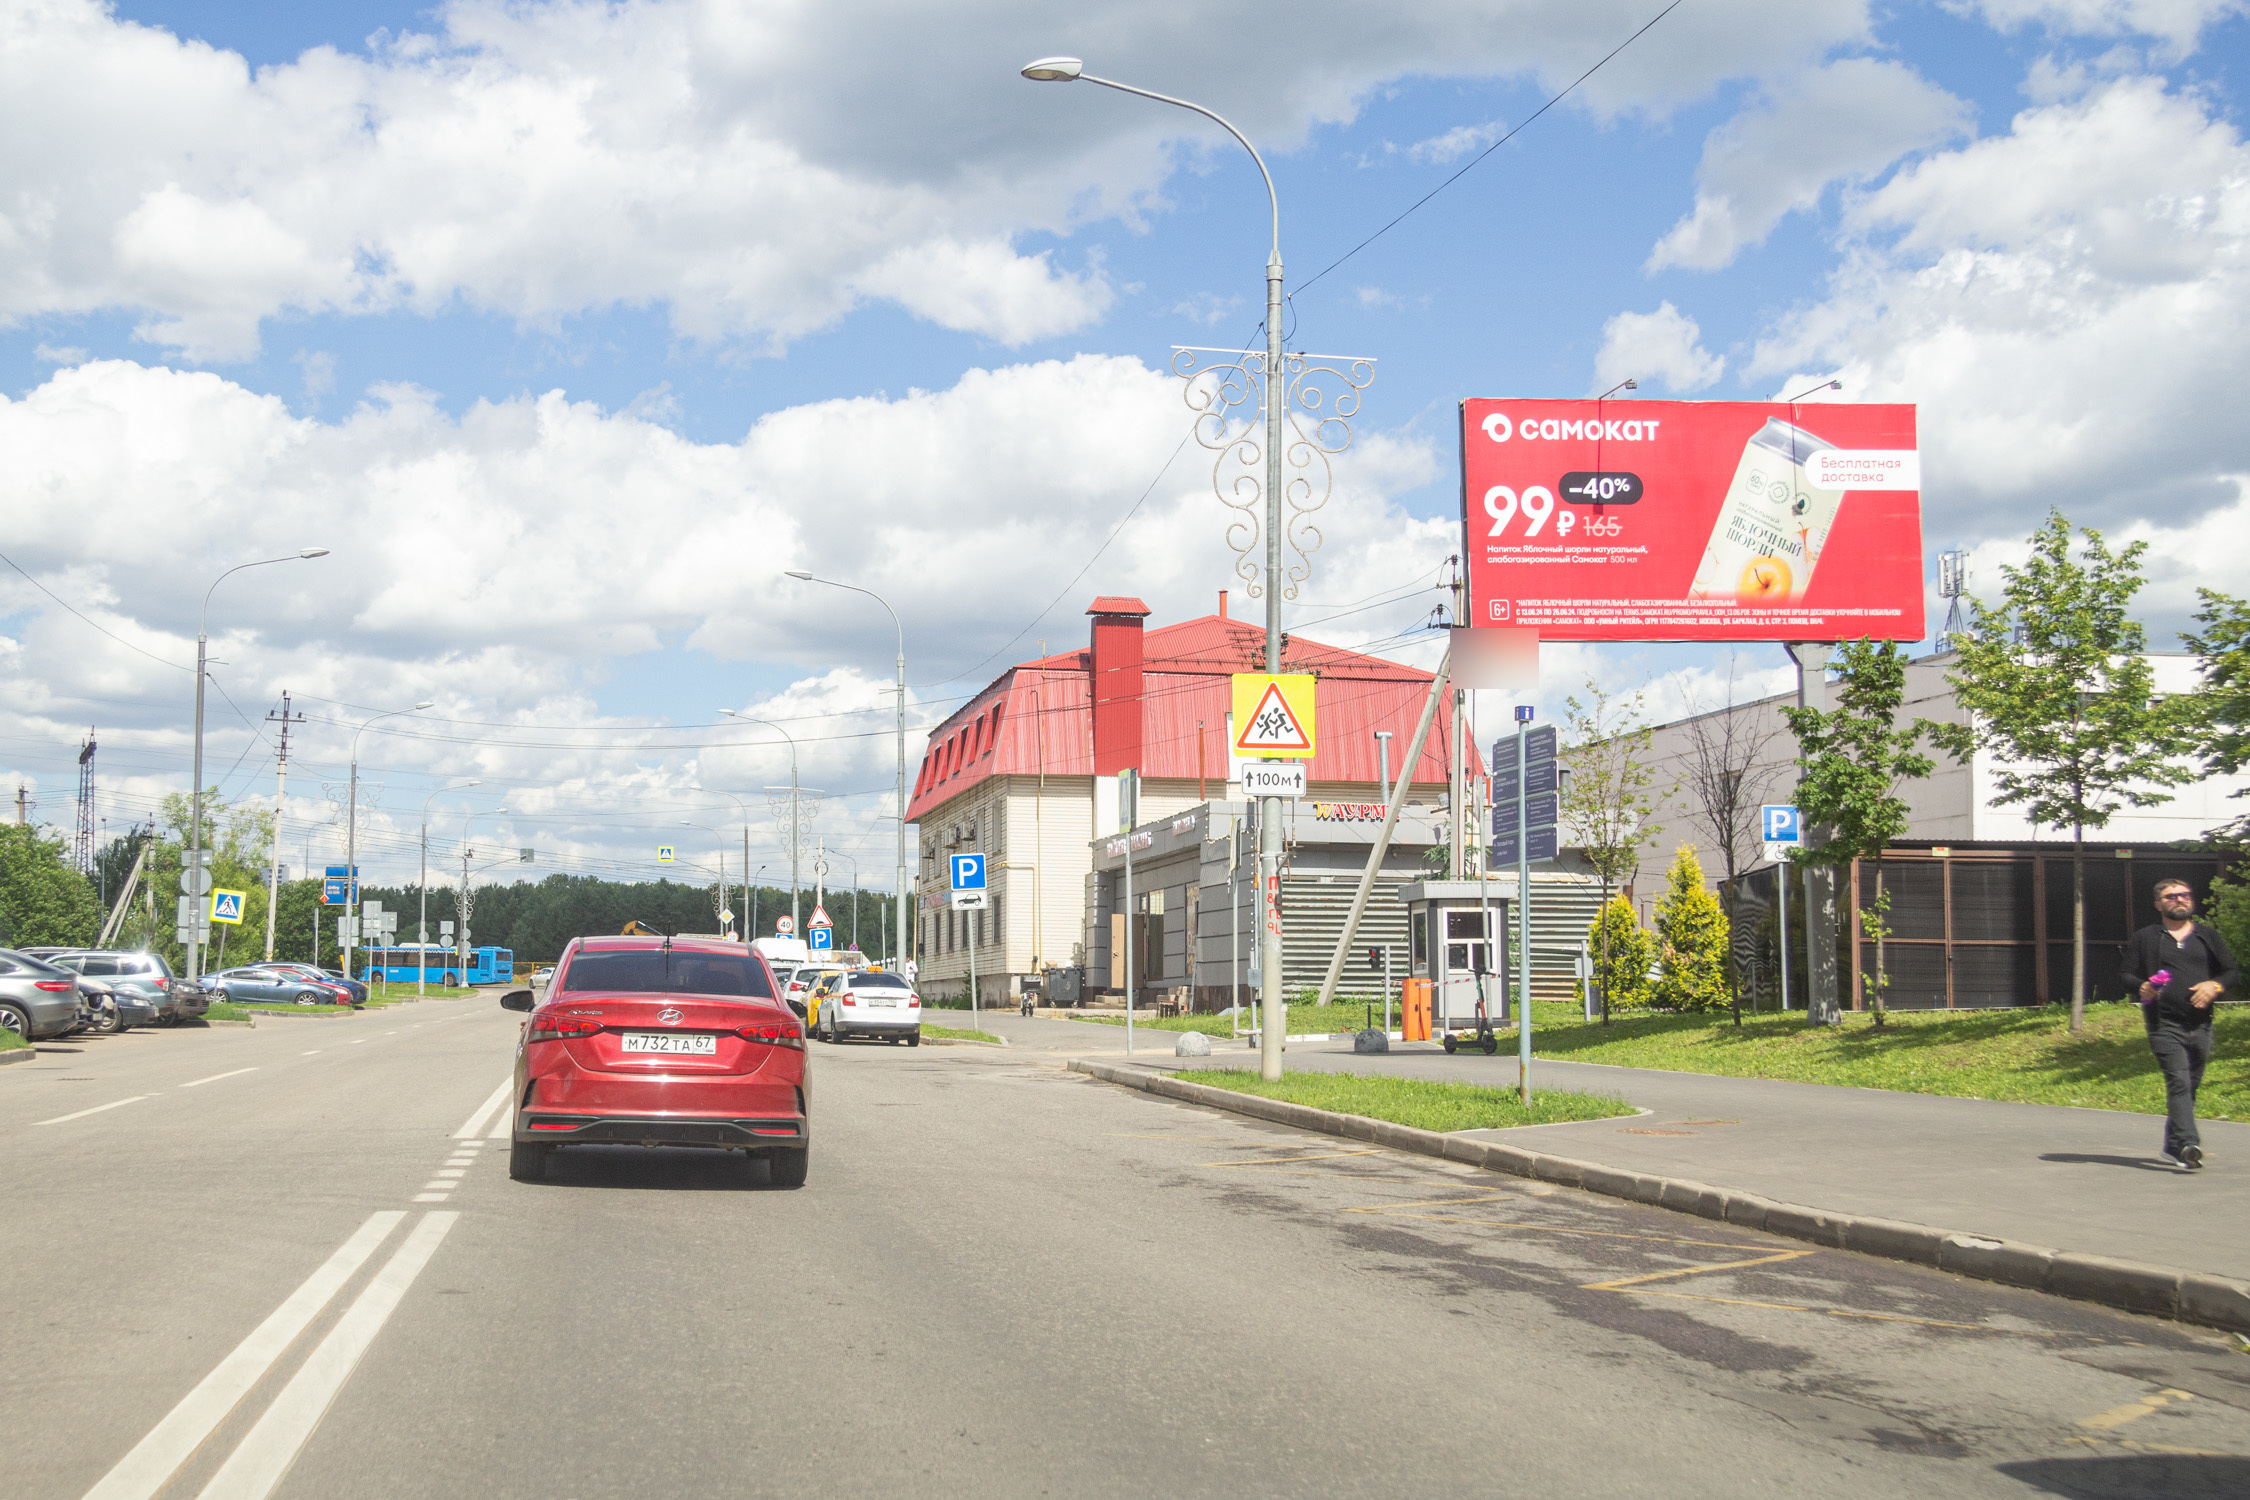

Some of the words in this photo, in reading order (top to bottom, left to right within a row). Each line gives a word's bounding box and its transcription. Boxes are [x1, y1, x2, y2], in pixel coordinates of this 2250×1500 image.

[1821, 456, 1901, 469] Бесплатная
[1821, 472, 1884, 483] доставка
[1583, 516, 1623, 537] 165
[1731, 515, 1802, 557] ЯБЛОЧНЫЙ
[1486, 545, 1522, 553] Напиток
[1522, 545, 1563, 553] Яблочный
[1592, 545, 1648, 555] натуральный,
[1726, 528, 1774, 559] ШОРЛИ
[1487, 555, 1570, 564] слабогазированный
[1610, 556, 1625, 564] 500
[1542, 598, 1572, 607] ЯБЛОЧНЫЙ
[1572, 599, 1591, 607] ШОРЛИ
[1493, 603, 1506, 616] 6+
[1515, 608, 1520, 616] С
[1543, 608, 1552, 616] ПО
[1576, 608, 1614, 617] ПОДРОБНОСТИ
[1615, 608, 1622, 616] НА
[1767, 608, 1772, 616] И
[1772, 608, 1791, 616] ТОЧНОЕ
[1791, 608, 1809, 616] ВРЕМЯ
[1809, 608, 1835, 617] ДОСТАВКИ
[1836, 608, 1864, 616] УТОЧНЯЙТЕ
[1869, 608, 1901, 616] МОБИЛЬНОМ
[1516, 617, 1552, 625] ПРИЛОЖЕНИИ
[1583, 617, 1595, 625] ООО
[1644, 617, 1659, 625] ОГРН
[1771, 810, 1790, 838] P
[958, 858, 978, 886] P
[780, 921, 791, 929] 40
[815, 931, 827, 948] P
